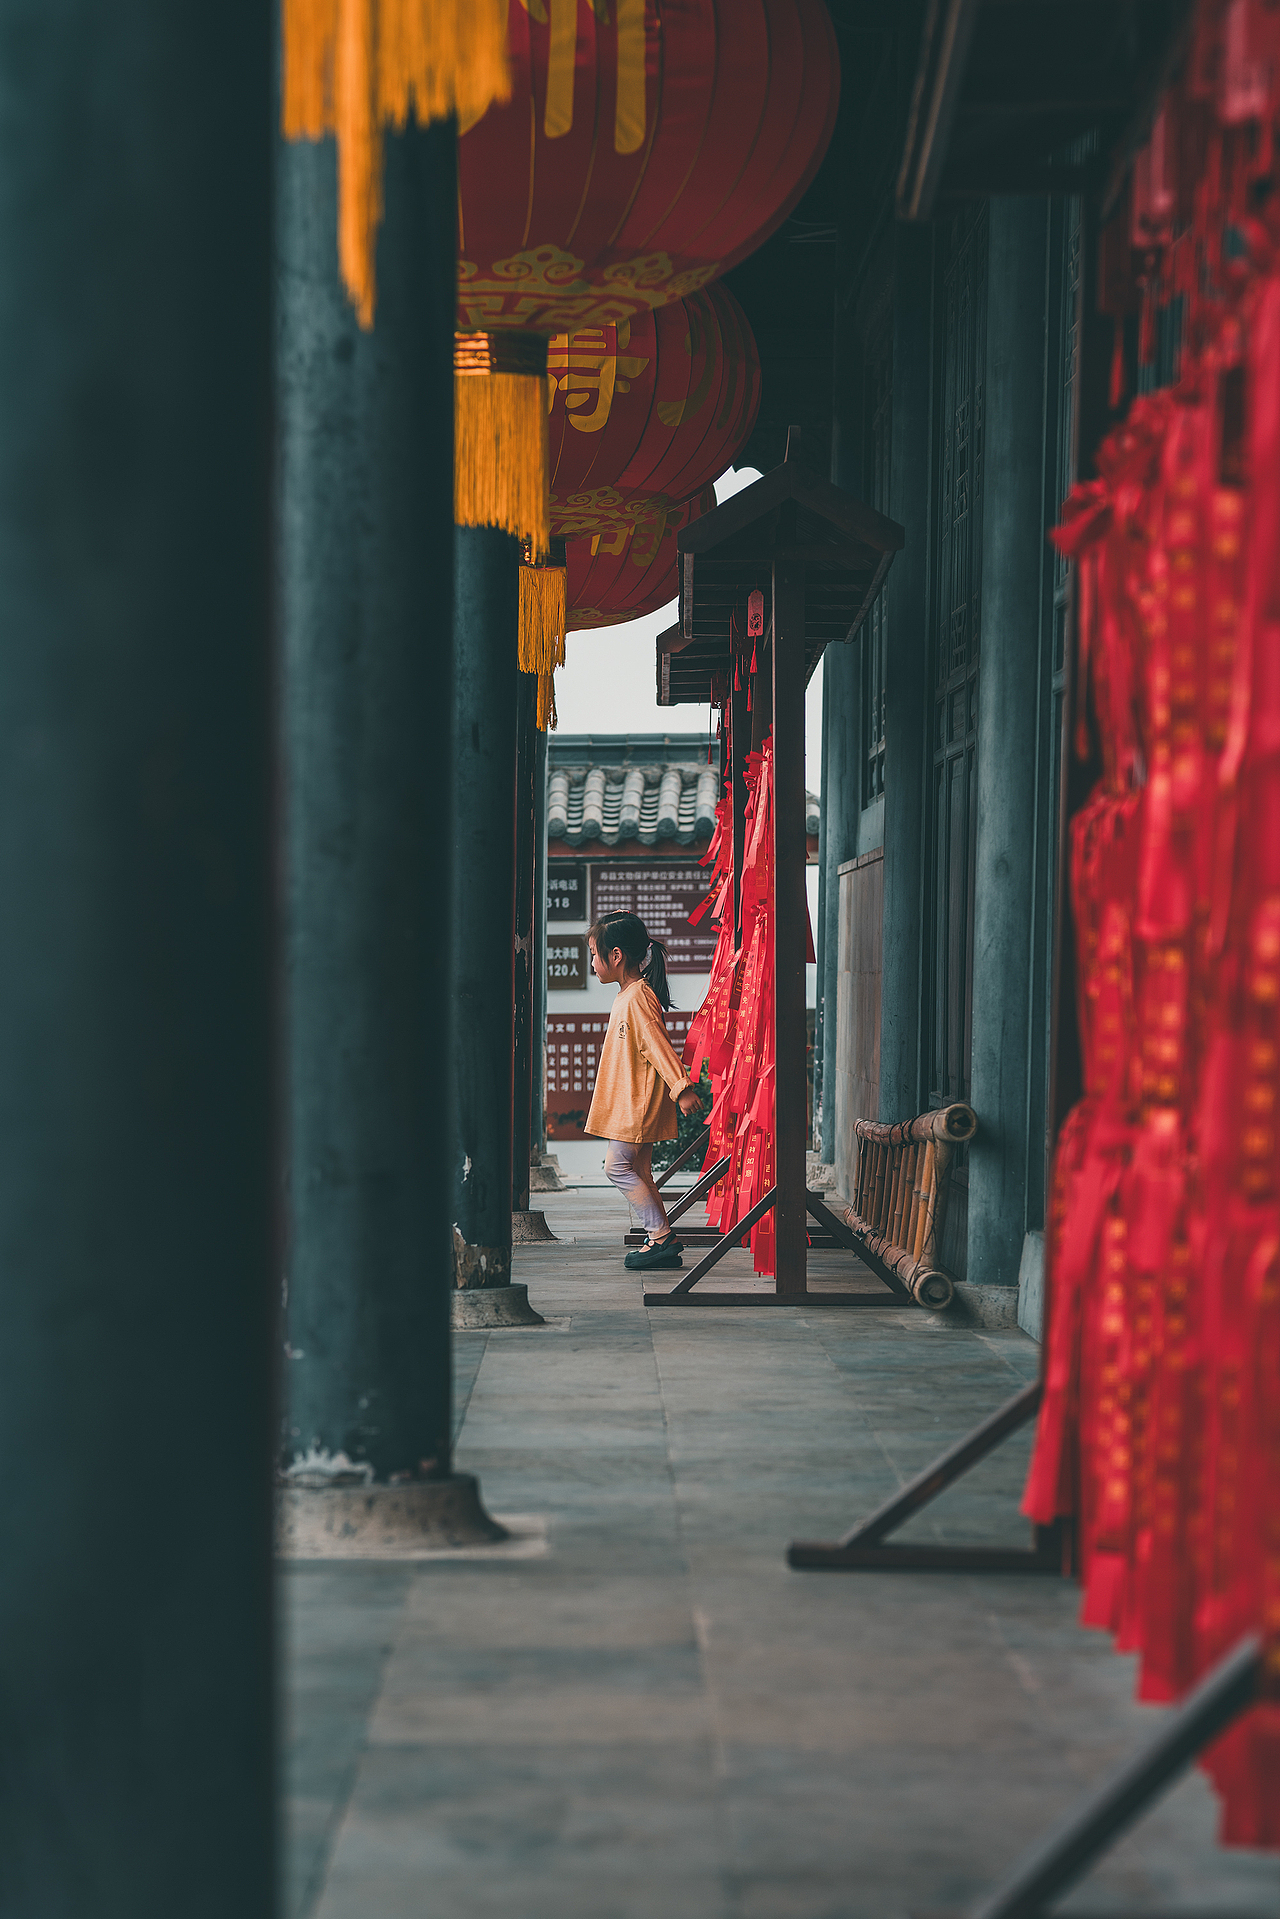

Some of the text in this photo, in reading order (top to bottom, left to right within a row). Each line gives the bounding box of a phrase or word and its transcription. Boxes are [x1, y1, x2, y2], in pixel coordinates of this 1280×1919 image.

[547, 879, 578, 891] 诉电话
[548, 964, 579, 977] 120人
